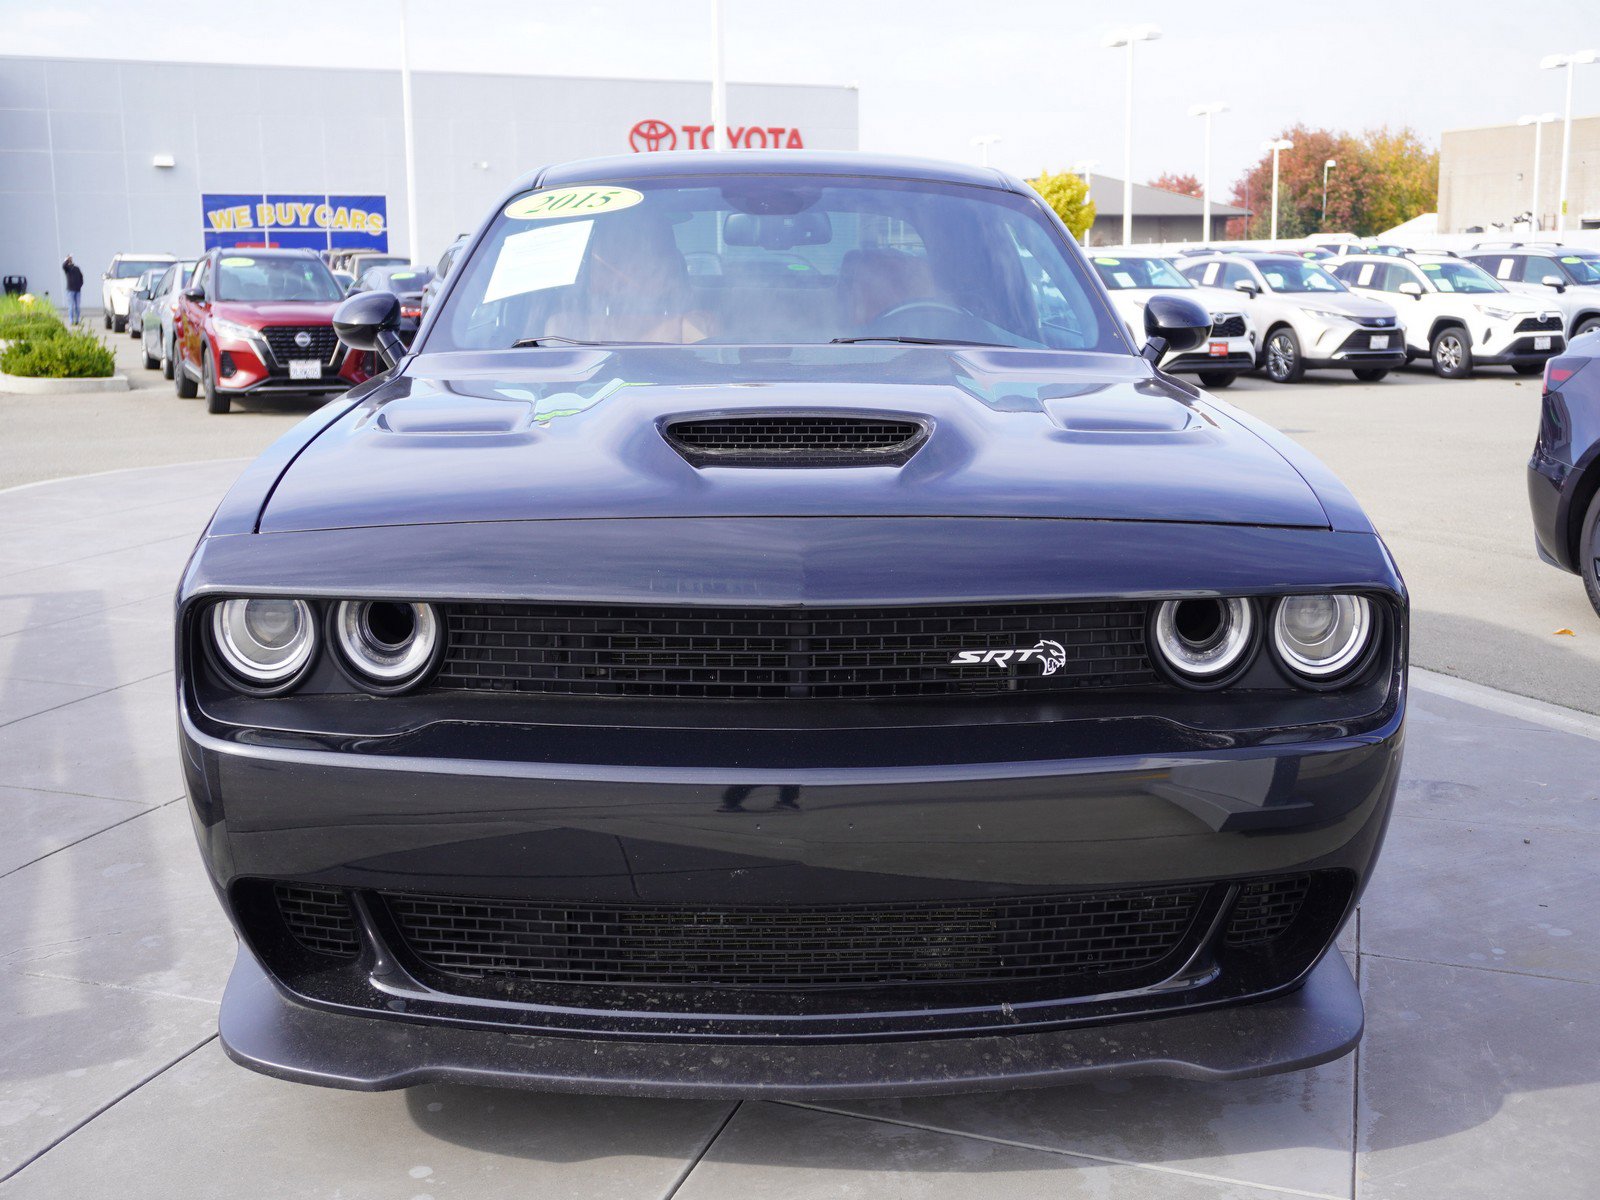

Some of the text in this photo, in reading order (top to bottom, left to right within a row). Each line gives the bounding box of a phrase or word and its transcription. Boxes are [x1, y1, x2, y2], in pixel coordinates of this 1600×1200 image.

[523, 191, 622, 215] 2015
[207, 202, 385, 236] WE BUY CARS
[950, 648, 1044, 668] SRT
